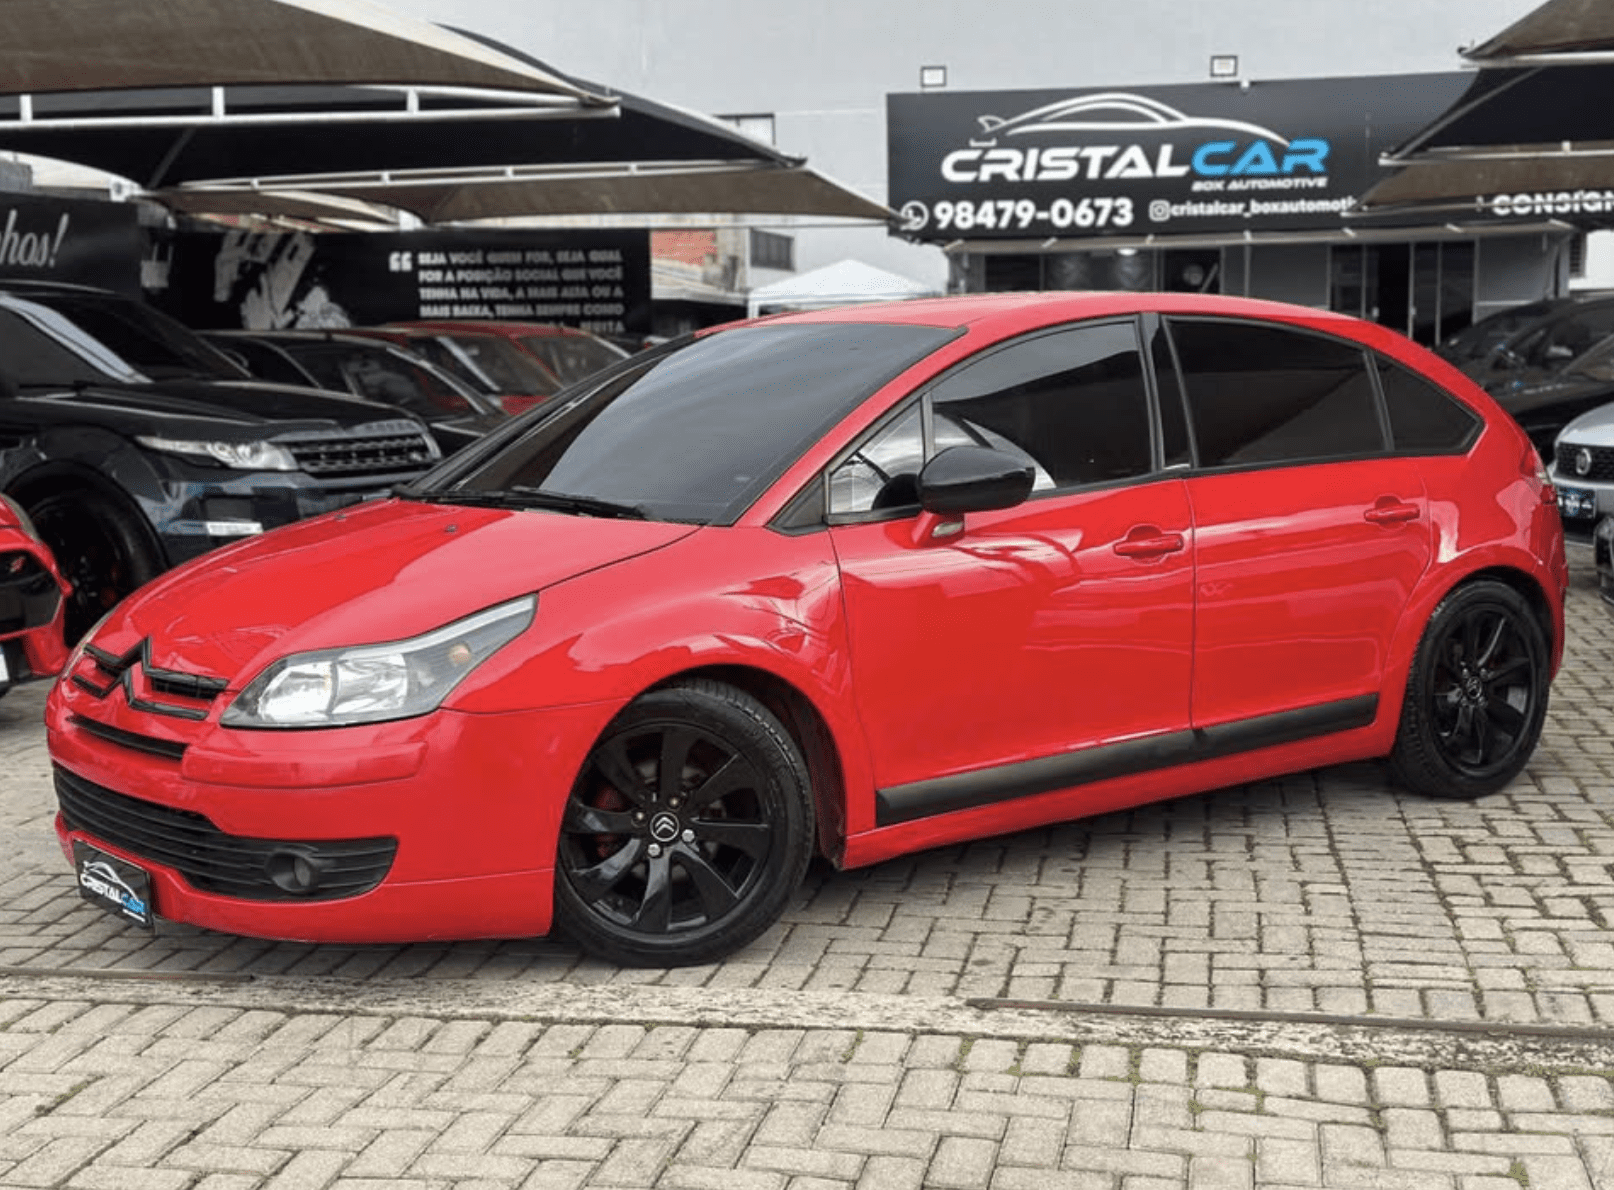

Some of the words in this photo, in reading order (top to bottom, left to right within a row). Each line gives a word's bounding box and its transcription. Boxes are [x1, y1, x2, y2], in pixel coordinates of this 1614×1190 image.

[1192, 179, 1226, 191] BOX
[1227, 177, 1329, 190] AUTOMOTIVE
[934, 199, 1134, 229] 98479-0673
[1171, 196, 1356, 217] cristalcar_boxautomoti
[0, 209, 69, 268] hos!
[418, 252, 447, 265] SEJA
[449, 250, 483, 264] VOCÊ
[445, 271, 455, 282] A
[515, 269, 559, 281] SOCIAL
[588, 265, 622, 280] VOCÊ
[420, 287, 458, 299] TENHA
[460, 287, 479, 299] NA
[480, 286, 514, 301] VIDA,
[515, 287, 525, 298] A
[592, 286, 611, 298] OU
[613, 286, 624, 298] A
[420, 305, 450, 317] MAIS
[453, 305, 495, 318] BAIXA,
[495, 305, 534, 317] TENHA
[583, 304, 625, 316] COMO
